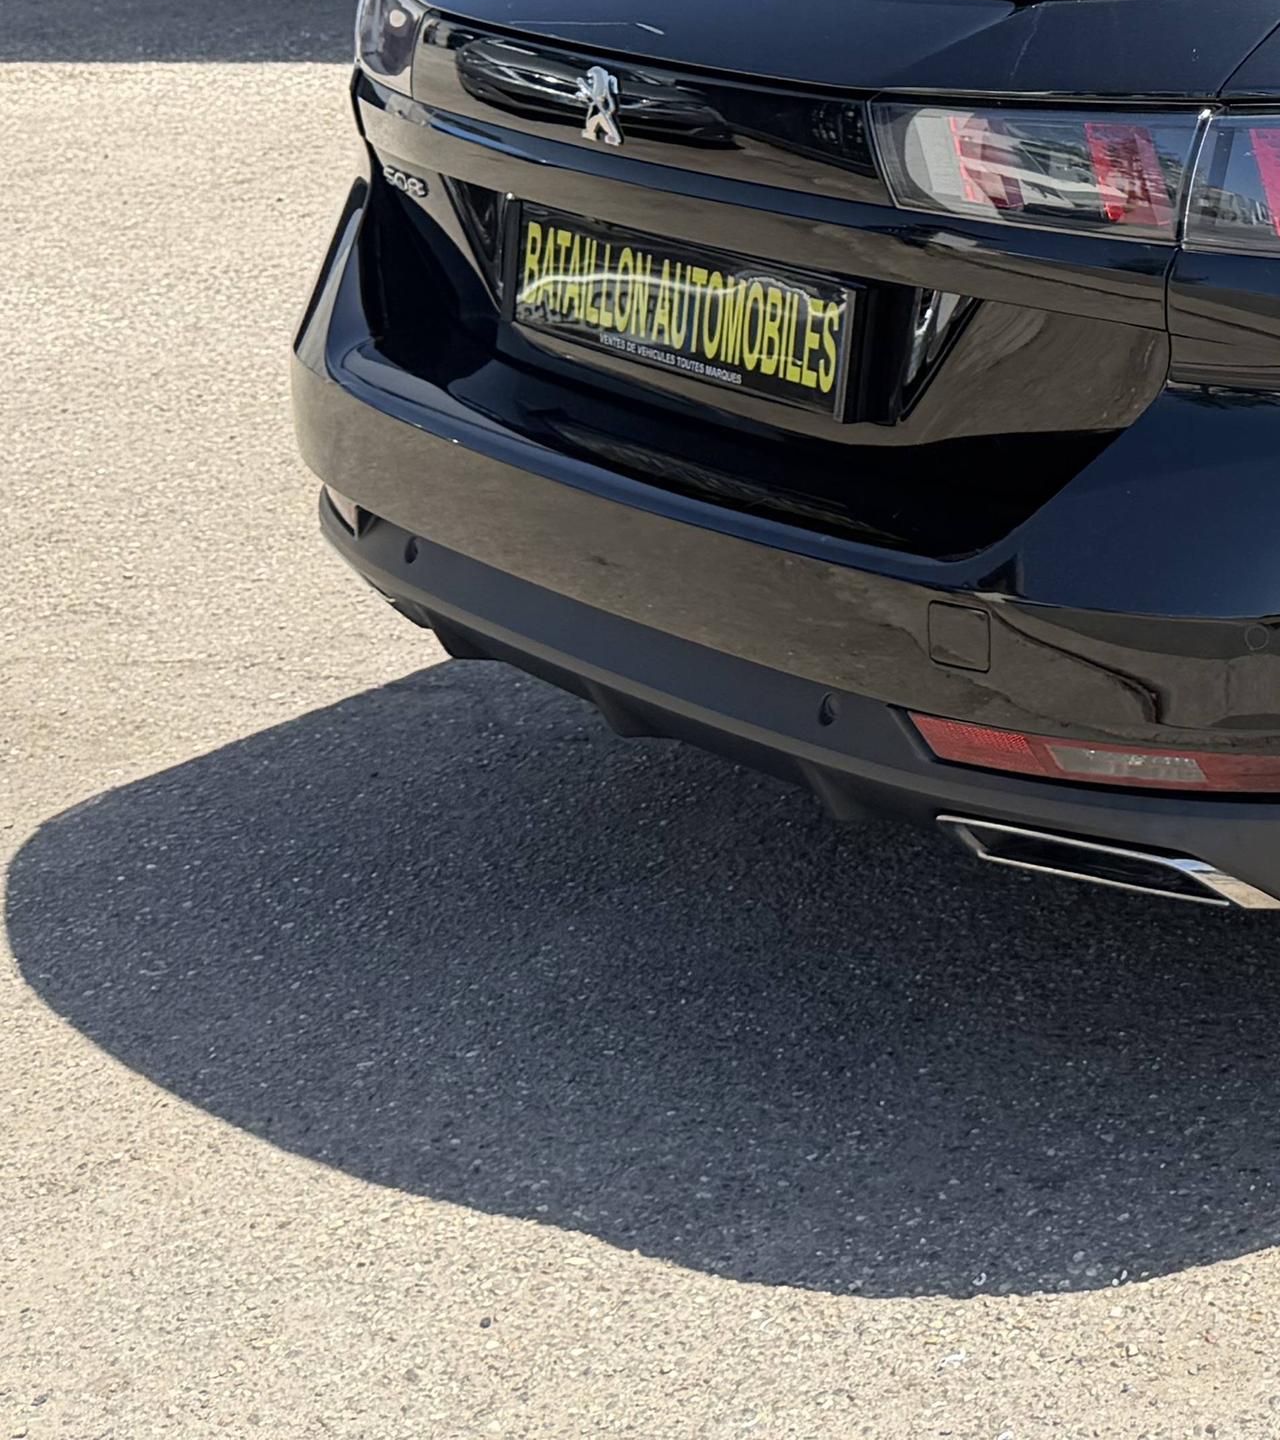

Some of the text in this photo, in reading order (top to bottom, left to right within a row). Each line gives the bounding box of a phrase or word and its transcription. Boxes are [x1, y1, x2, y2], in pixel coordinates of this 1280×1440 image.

[521, 220, 839, 393] BATAILLON AUTOMOBILES
[600, 333, 627, 350] VENTES
[626, 341, 637, 354] DE
[676, 356, 705, 374] TOUTES
[705, 365, 742, 385] MARQUES
